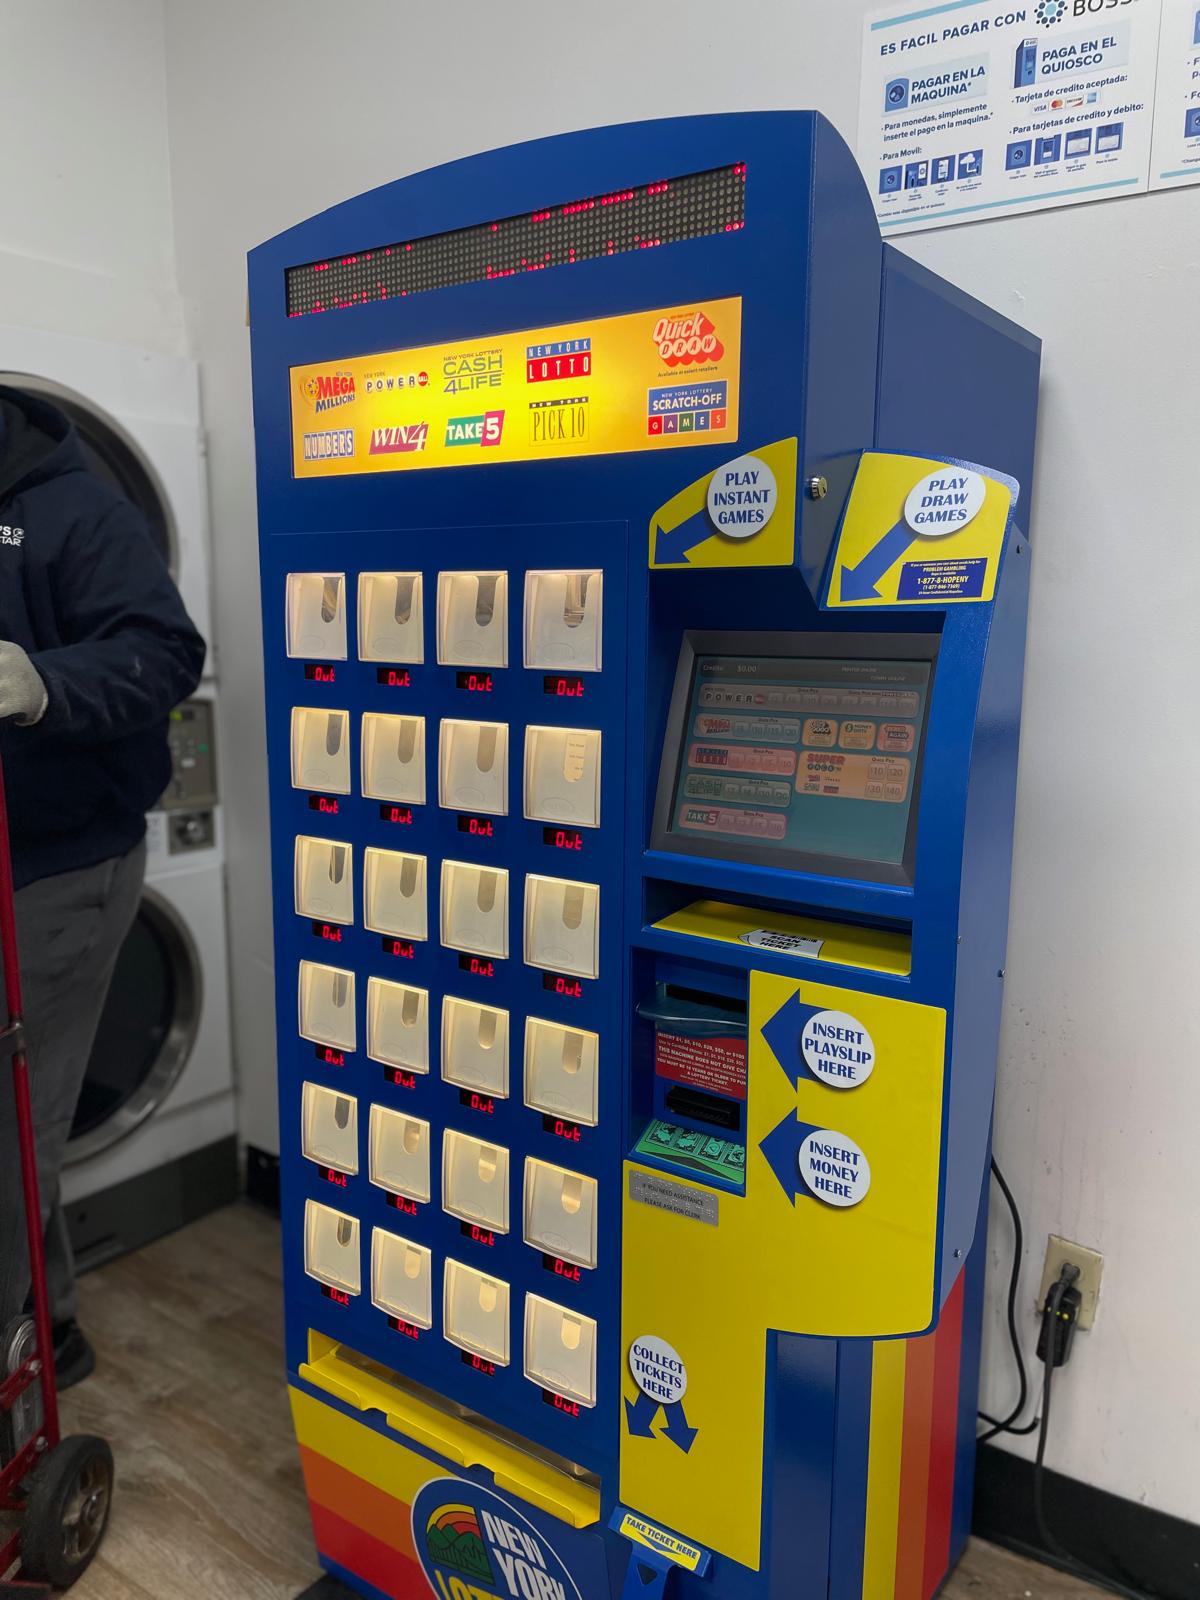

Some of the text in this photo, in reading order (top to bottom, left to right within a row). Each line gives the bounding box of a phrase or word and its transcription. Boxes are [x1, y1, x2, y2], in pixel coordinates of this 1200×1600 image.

[880, 43, 896, 56] ES
[900, 32, 938, 51] FACIL
[942, 19, 990, 41] PAGAR
[994, 10, 1026, 28] CON
[1042, 36, 1117, 62] PAGA EN EL
[1042, 53, 1103, 75] QUIOSCO
[912, 66, 986, 91] PAGAR EN LA
[1016, 74, 1128, 106] Tarjeta de credito aceptada:
[884, 104, 988, 132] Para monedas, simplemente
[1012, 103, 1144, 134] Para tarjetas de credito y debito:
[884, 130, 908, 142] inserte
[910, 128, 916, 136] el
[917, 126, 936, 137] pago
[947, 120, 954, 128] la
[882, 146, 922, 160] Para Movil:
[653, 312, 705, 344] Quick
[458, 352, 474, 360] YORK
[528, 340, 588, 358] NEW YORK
[660, 335, 716, 358] DRAW
[443, 354, 502, 376] CASH
[530, 356, 589, 380] LOTTO
[317, 376, 356, 400] MEGA
[443, 373, 502, 394] 4LIFE
[316, 394, 356, 414] MILLIONS
[652, 394, 722, 411] SCRATCH-OFF
[446, 416, 500, 440] TAKE 5
[533, 406, 585, 442] PICK 10
[652, 416, 721, 430] GAMES
[304, 431, 353, 458] NUMBERS
[726, 470, 760, 486] PLAY
[928, 478, 968, 492] PLAY
[714, 490, 770, 506] INSTANT
[921, 493, 968, 508] DRAW
[718, 509, 764, 524] GAMES
[914, 508, 968, 524] GAMES
[918, 576, 969, 584] 1-877-8-HOPENY
[807, 753, 846, 765] SUPER
[760, 938, 801, 948] TICKET
[760, 942, 790, 950] HERE
[770, 936, 801, 944] SCAN
[812, 1022, 864, 1045] INSERT
[658, 1046, 670, 1054] THIS
[671, 1049, 694, 1060] MACHINE
[695, 1055, 709, 1064] DOES
[722, 1063, 735, 1072] GIVE
[804, 1038, 872, 1065] PLAYSLIP
[691, 1072, 710, 1081] LOTTERY
[692, 1066, 706, 1074] YEARS
[818, 1058, 856, 1080] HERE
[810, 1140, 860, 1166] INSERT
[810, 1158, 858, 1182] MONEY
[648, 1184, 658, 1192] YOU
[658, 1187, 672, 1196] NEED
[673, 1191, 704, 1206] ASSISTANCE
[814, 1176, 852, 1199] HERE
[673, 1206, 684, 1214] FOR
[634, 1344, 684, 1374] COLLECT
[634, 1358, 682, 1388] TICKETS
[642, 1378, 674, 1400] HERE
[480, 1510, 547, 1570] NEW
[626, 1516, 698, 1560] TAKE TICKET HERE
